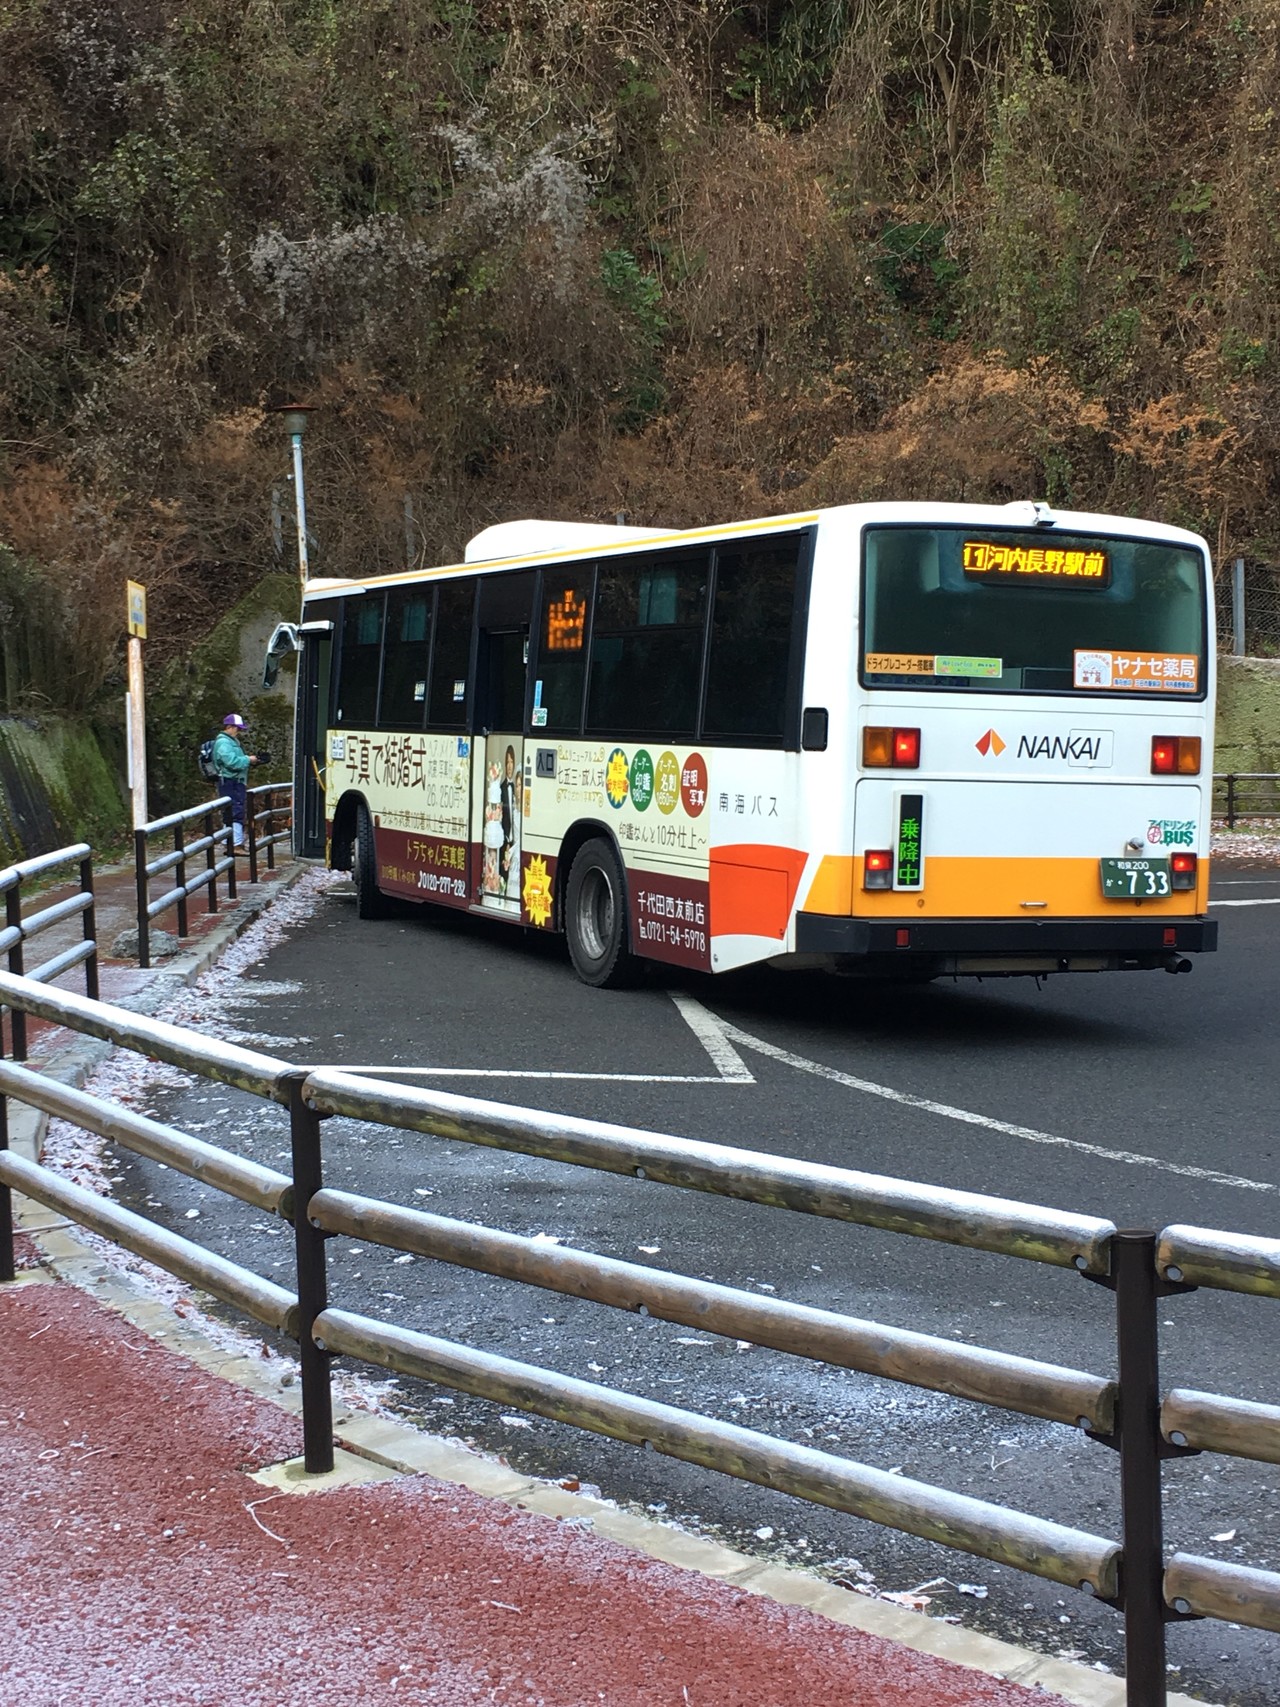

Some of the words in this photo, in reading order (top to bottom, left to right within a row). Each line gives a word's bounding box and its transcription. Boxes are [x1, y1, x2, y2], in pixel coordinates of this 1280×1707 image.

[1113, 656, 1196, 679] ヤナセ薬局
[1017, 735, 1101, 760] NANKAI
[346, 735, 427, 791] 写真で結婚式
[537, 751, 554, 773] 入口
[635, 771, 651, 791] 印鑑
[682, 769, 699, 788] 証明
[689, 789, 705, 807] 写真
[719, 792, 779, 817] 南海バス
[1163, 830, 1194, 847] BUS
[406, 839, 466, 871] トラちゃん写真館
[898, 818, 920, 885] 乗降中
[637, 890, 705, 925] 千代田西友前店
